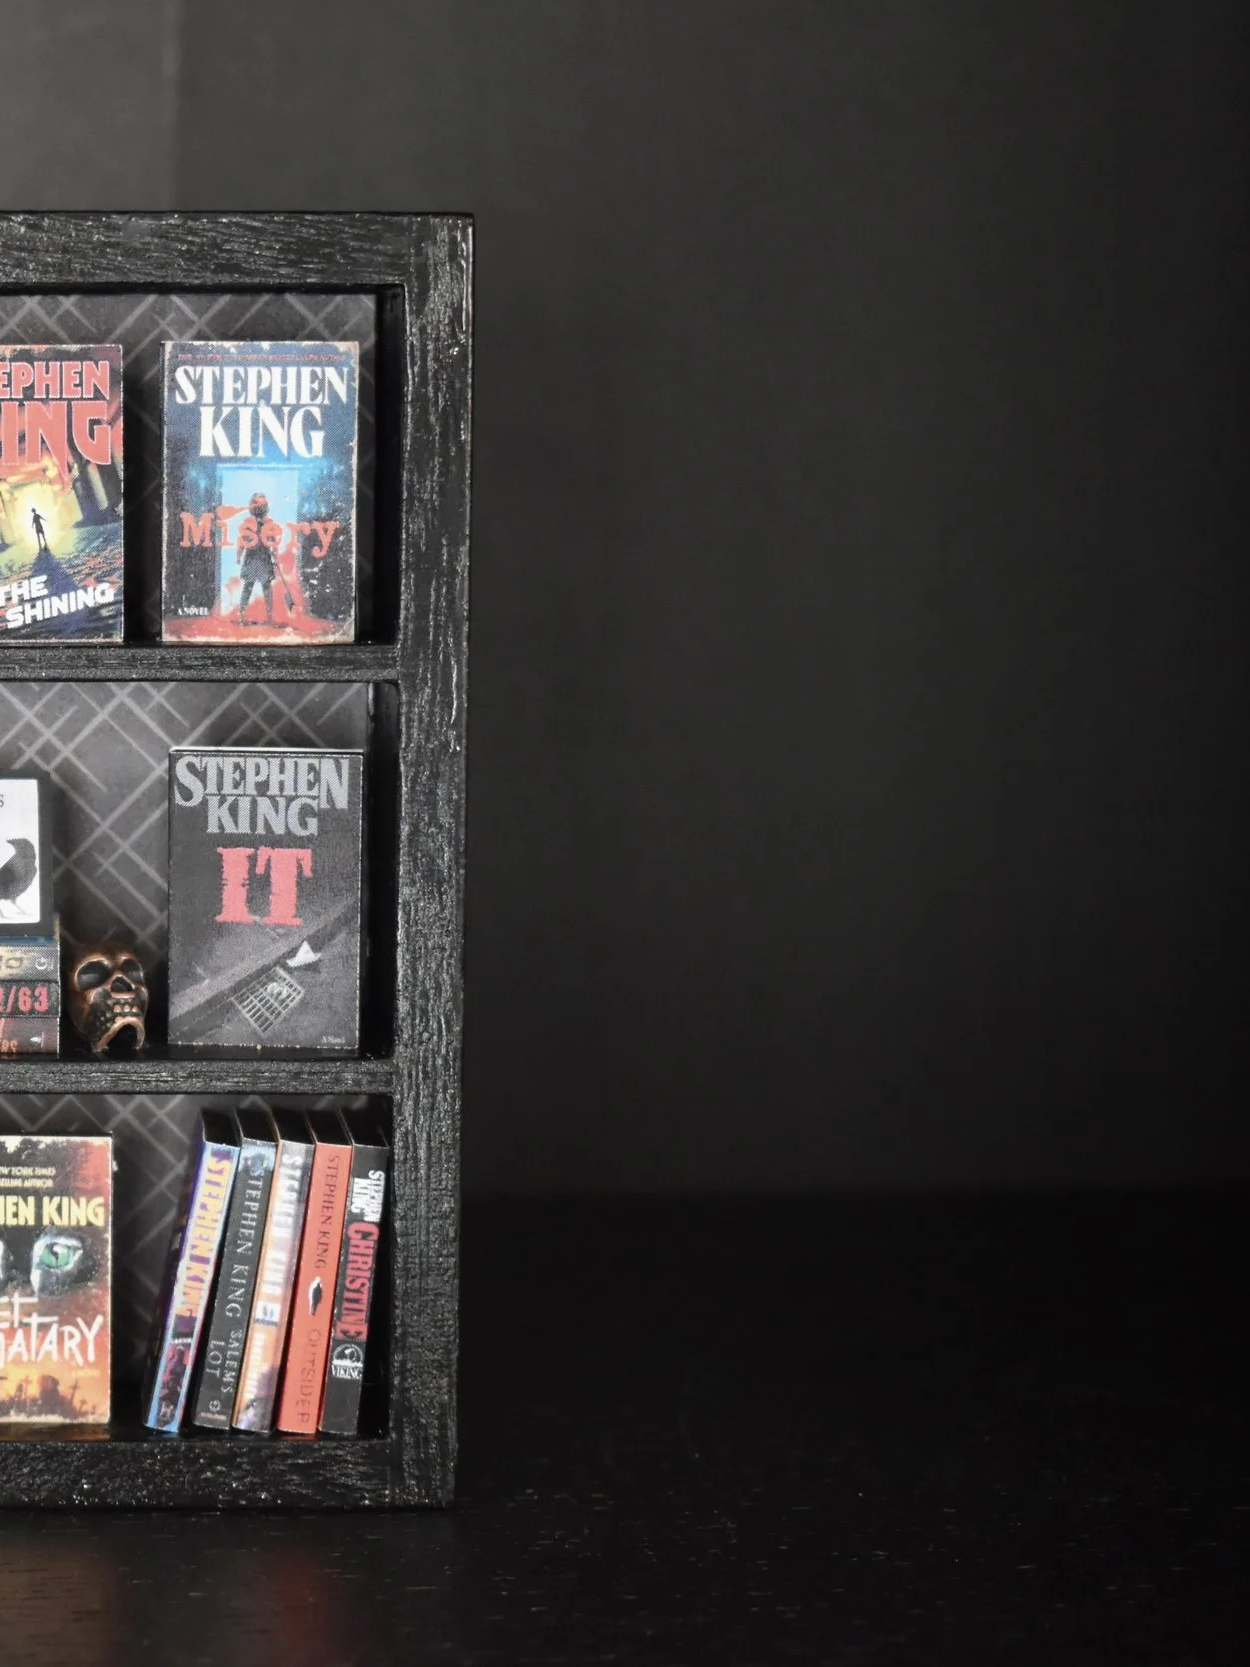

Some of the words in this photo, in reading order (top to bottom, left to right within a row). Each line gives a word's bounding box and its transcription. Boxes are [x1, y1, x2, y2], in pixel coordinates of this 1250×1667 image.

[175, 365, 349, 405] STEPHEN
[199, 402, 325, 458] KING
[180, 510, 340, 559] Misery
[5, 582, 116, 629] SHINING
[174, 755, 349, 809] STEPHEN
[206, 796, 318, 836] KING
[215, 846, 313, 925] IT
[11, 1166, 34, 1176] YORK
[35, 1166, 56, 1176] TIMES
[23, 1178, 54, 1188] AUTHOR
[271, 1154, 304, 1238] STEPHEN
[321, 1155, 340, 1225] STEPHEN
[350, 1177, 371, 1213] KING
[363, 1169, 385, 1222] STEPHEN
[42, 1195, 106, 1227] KING
[189, 1158, 232, 1257] STEPHEN
[236, 1169, 265, 1255] STEPHEN
[314, 1229, 332, 1269] KING
[175, 1259, 209, 1318] KING
[225, 1263, 249, 1318] KING
[335, 1221, 380, 1342] CHRISTINE
[206, 1340, 225, 1378] LOT
[331, 1364, 363, 1380] VIKING
